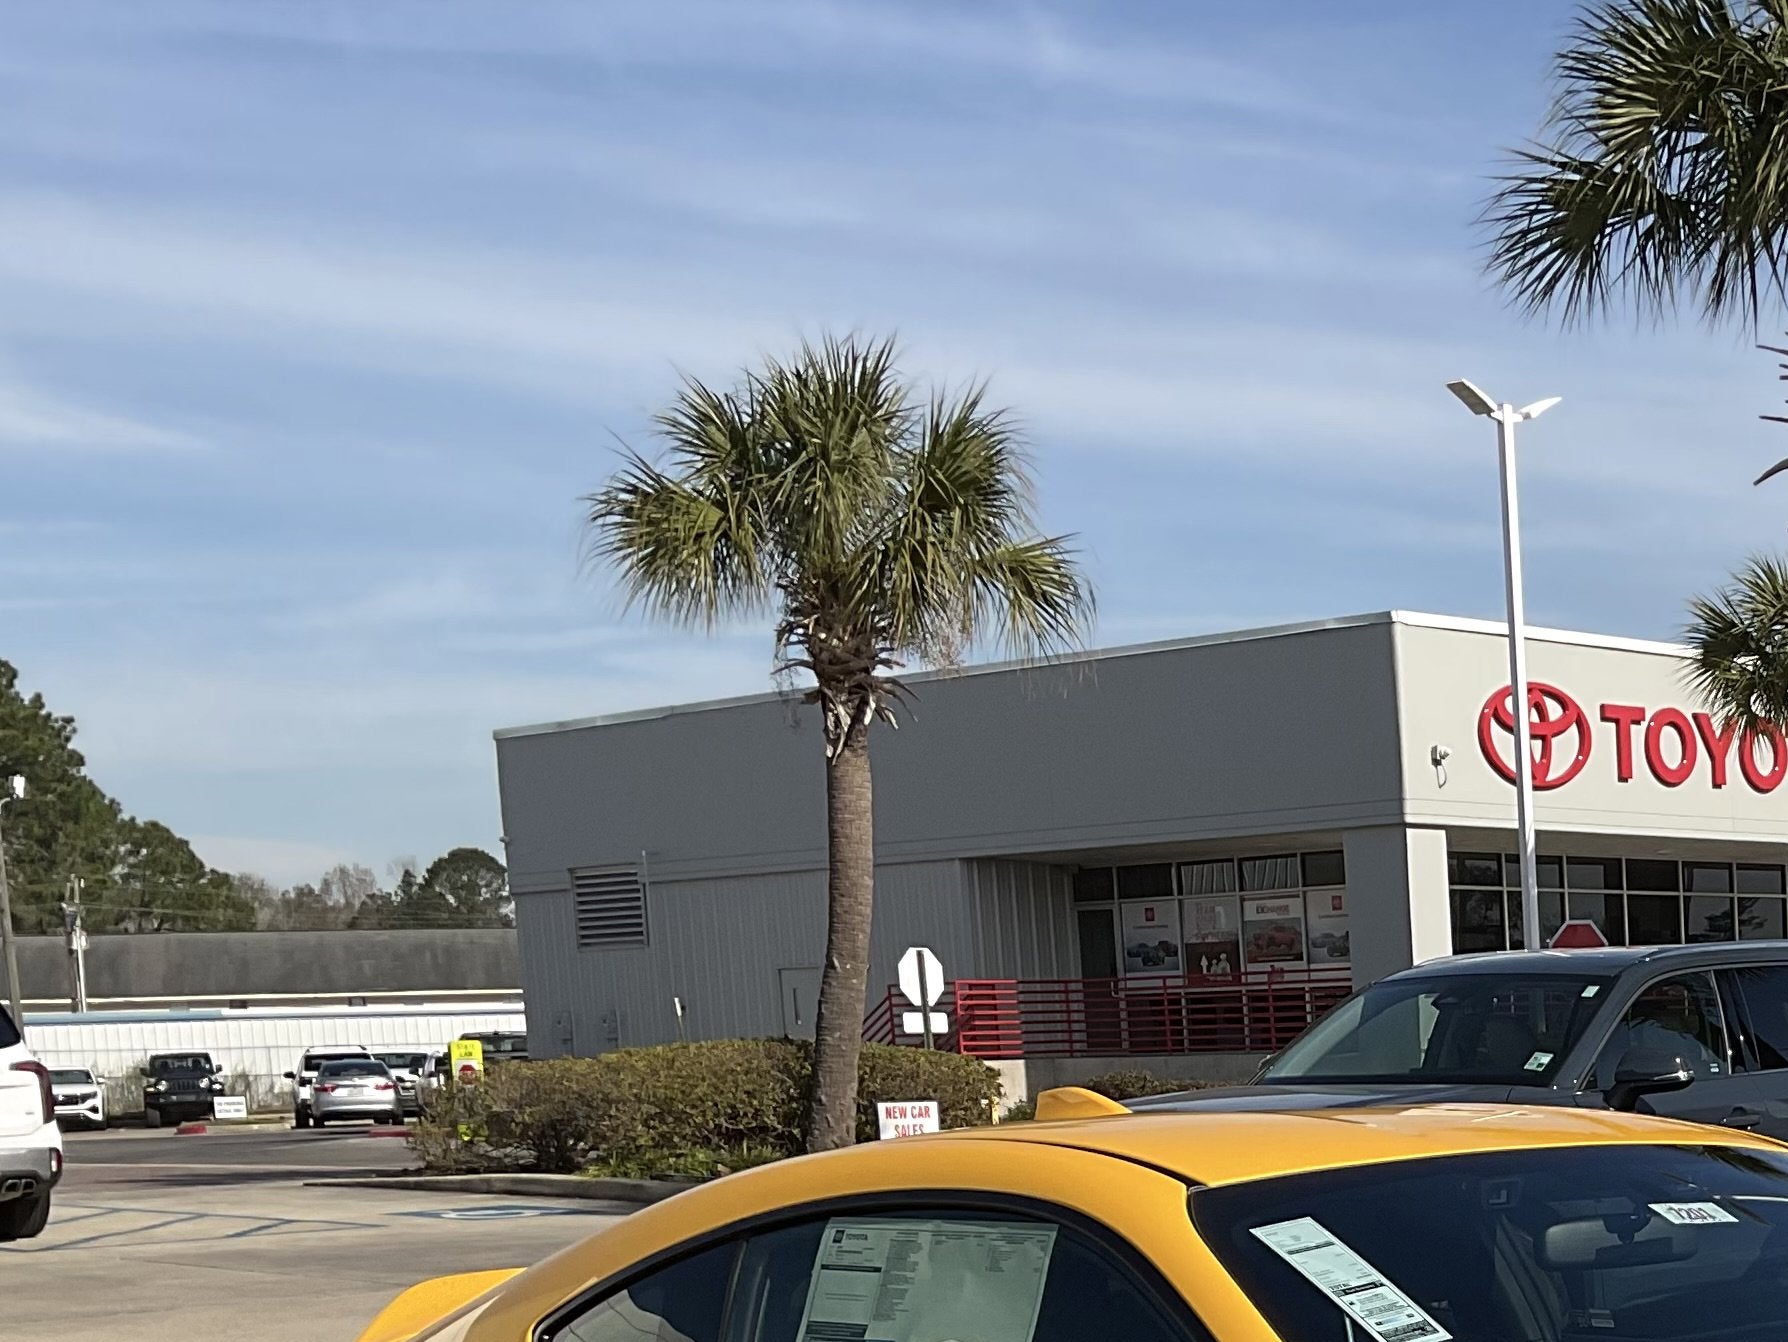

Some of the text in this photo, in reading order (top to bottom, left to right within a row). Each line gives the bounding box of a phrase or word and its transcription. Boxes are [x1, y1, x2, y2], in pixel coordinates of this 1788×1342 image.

[885, 1105, 931, 1120] NEW CAR
[894, 1123, 925, 1138] SALES
